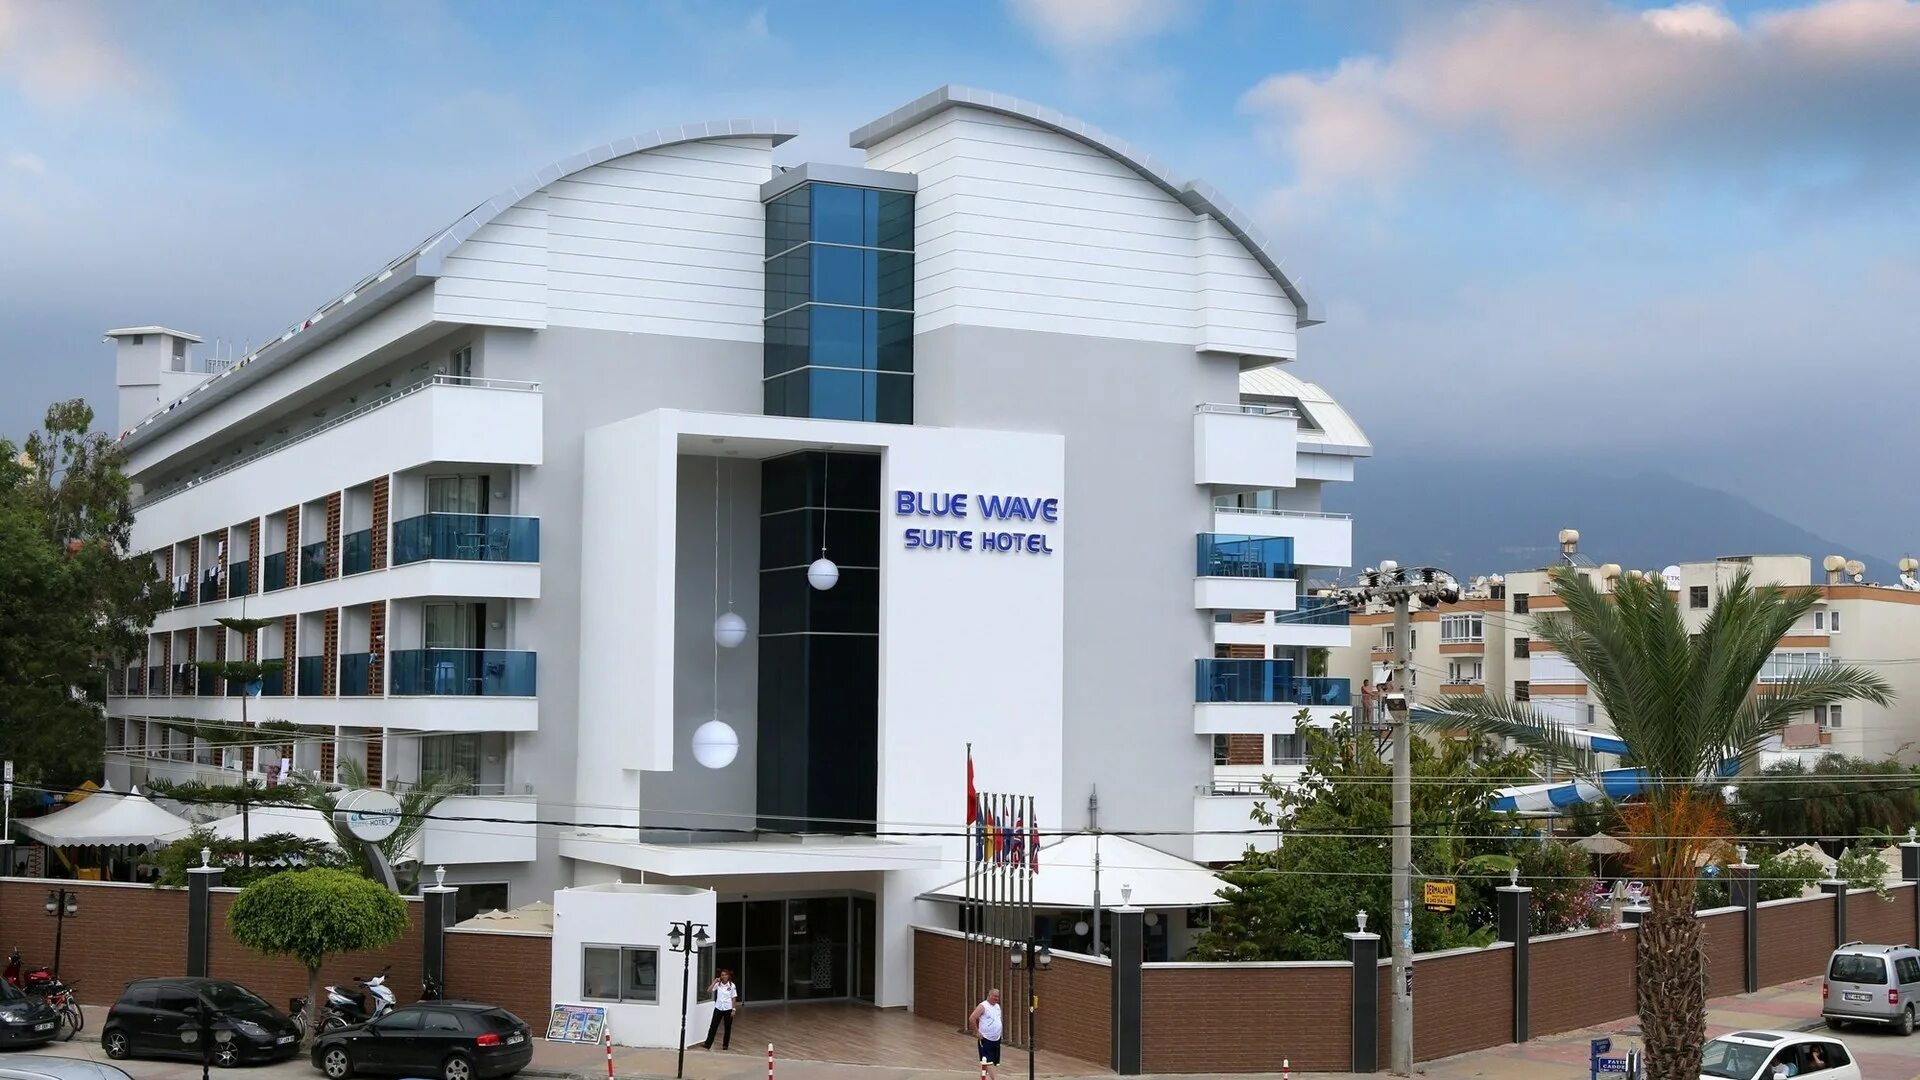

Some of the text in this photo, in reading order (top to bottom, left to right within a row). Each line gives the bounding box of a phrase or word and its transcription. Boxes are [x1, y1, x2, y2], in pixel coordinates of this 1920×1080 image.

[896, 490, 1058, 521] BLUE WAVE
[905, 528, 1053, 553] SUITE HOTEL
